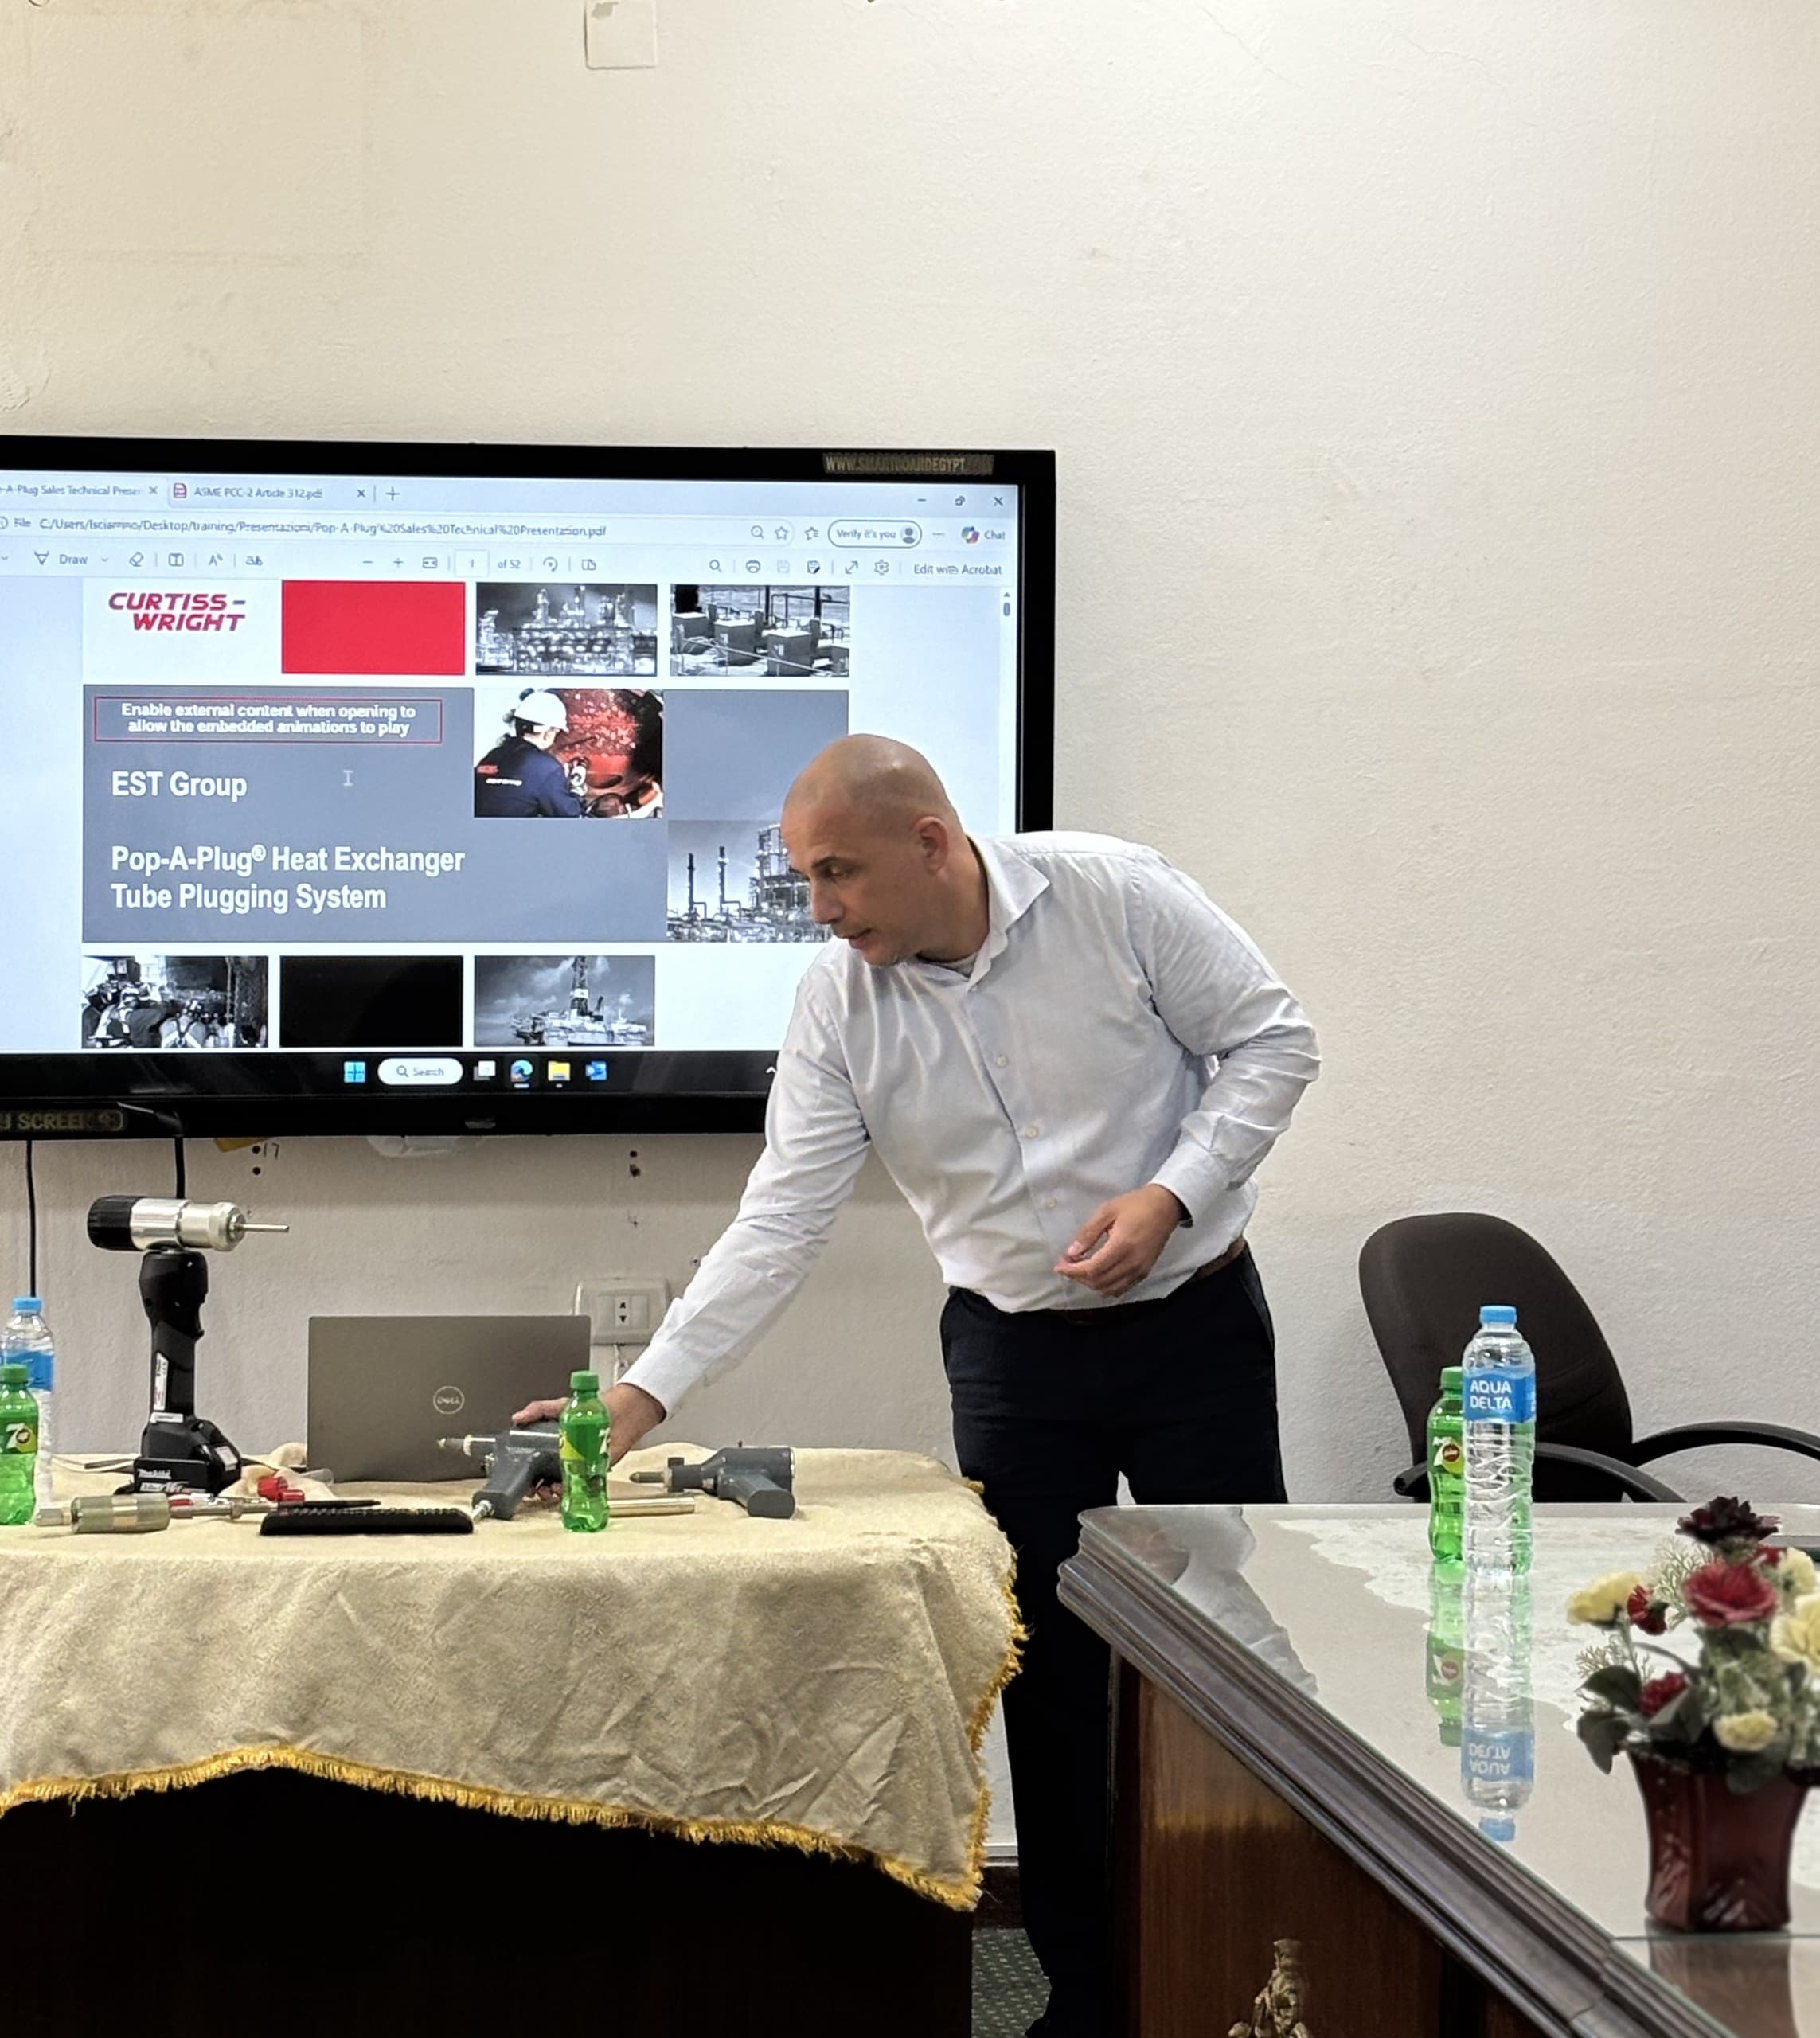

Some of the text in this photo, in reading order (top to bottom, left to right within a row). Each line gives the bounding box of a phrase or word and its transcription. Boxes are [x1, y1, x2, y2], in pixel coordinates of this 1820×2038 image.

[41, 486, 65, 494] Sales
[68, 486, 110, 495] Technical
[194, 488, 221, 497] ASME
[256, 489, 285, 498] Article
[14, 518, 31, 527] File
[837, 529, 861, 540] Verify
[880, 532, 896, 541] you
[984, 530, 1006, 540] Chat
[59, 555, 88, 564] Draw
[498, 559, 506, 568] of
[510, 560, 521, 569] 52
[914, 564, 934, 574] Edit
[962, 564, 1002, 574] Acrobat
[133, 613, 245, 631] WRIGHT
[121, 703, 416, 720] Enable external content when opening to
[128, 720, 410, 738] allow the embedded animations to play
[112, 771, 247, 802] EST Group
[272, 846, 328, 871] Heat
[335, 846, 465, 877] Exchanger
[111, 883, 386, 914] Tube Plugging System
[412, 1068, 444, 1076] Search
[1470, 1380, 1512, 1394] AQUA
[1470, 1395, 1512, 1410] DELTA
